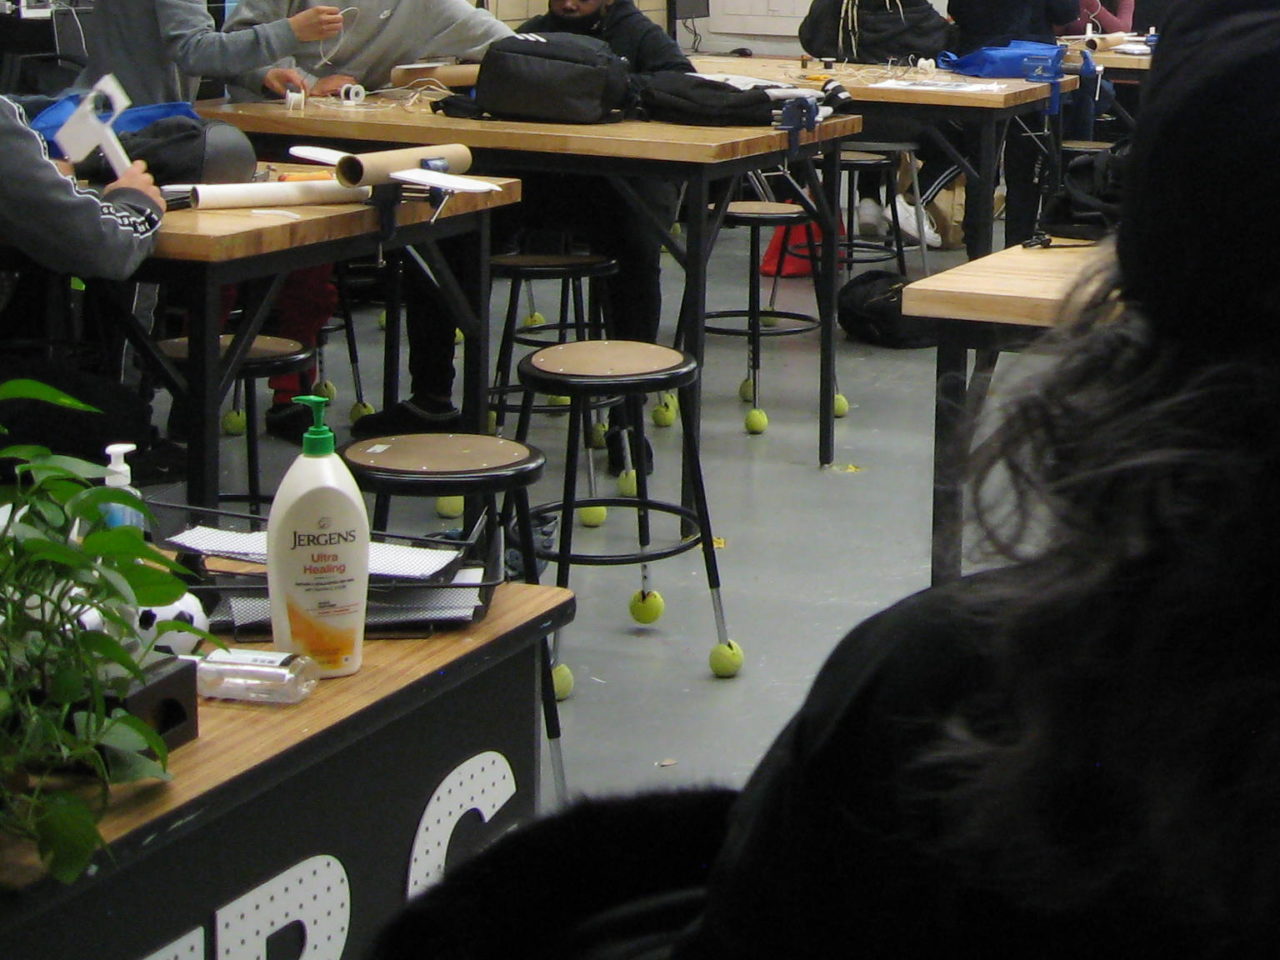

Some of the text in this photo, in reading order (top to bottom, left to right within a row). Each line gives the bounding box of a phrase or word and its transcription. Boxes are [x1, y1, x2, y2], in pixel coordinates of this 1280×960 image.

[291, 530, 356, 550] JERGENS
[311, 553, 338, 563] Ultra
[303, 564, 346, 574] Healing
